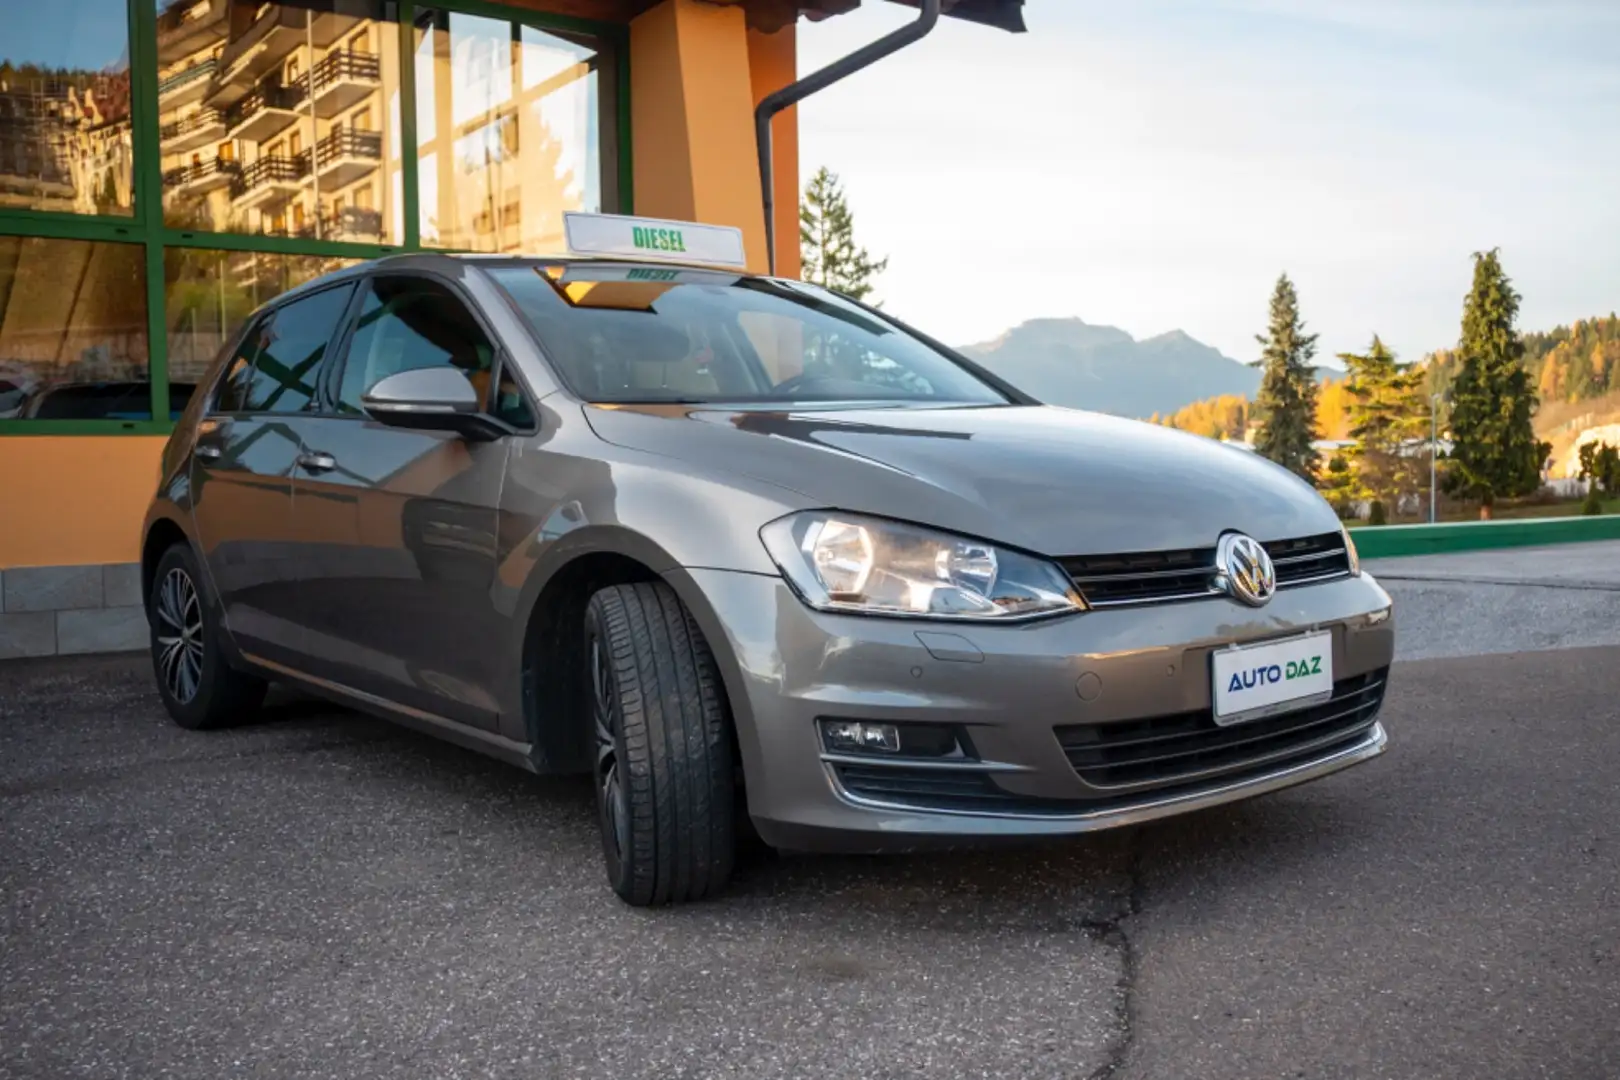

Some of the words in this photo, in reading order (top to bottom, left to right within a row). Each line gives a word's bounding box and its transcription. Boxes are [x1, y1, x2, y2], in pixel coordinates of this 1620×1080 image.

[632, 226, 686, 252] DIESEL
[1228, 664, 1281, 693] AUTO
[1285, 655, 1322, 681] DAZ
